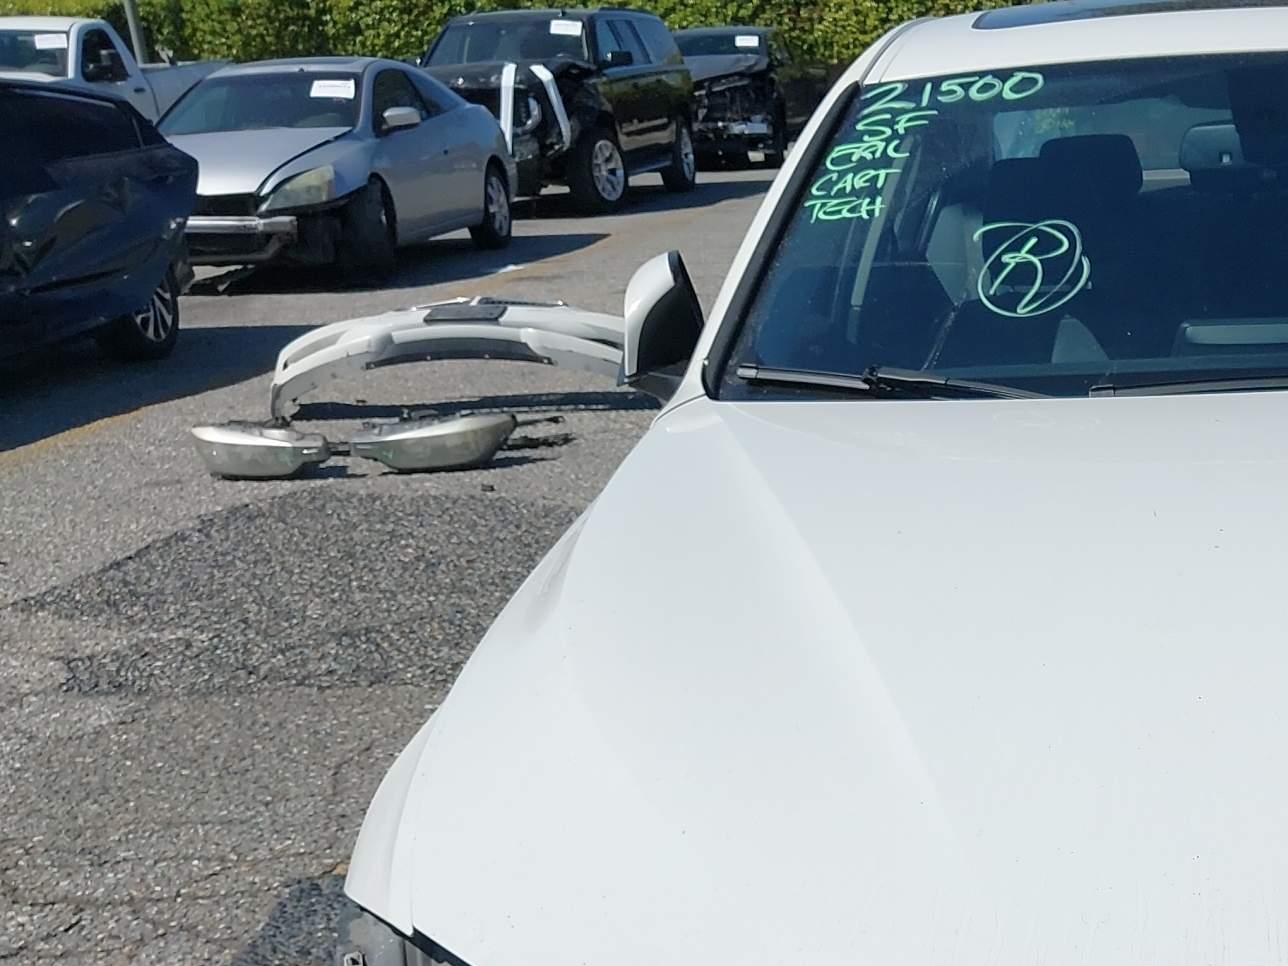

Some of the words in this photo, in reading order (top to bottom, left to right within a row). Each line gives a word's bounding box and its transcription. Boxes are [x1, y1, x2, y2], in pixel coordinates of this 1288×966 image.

[858, 71, 1045, 117] 21500
[855, 110, 938, 141] SF
[811, 169, 902, 196] CART
[804, 196, 886, 224] TECH
